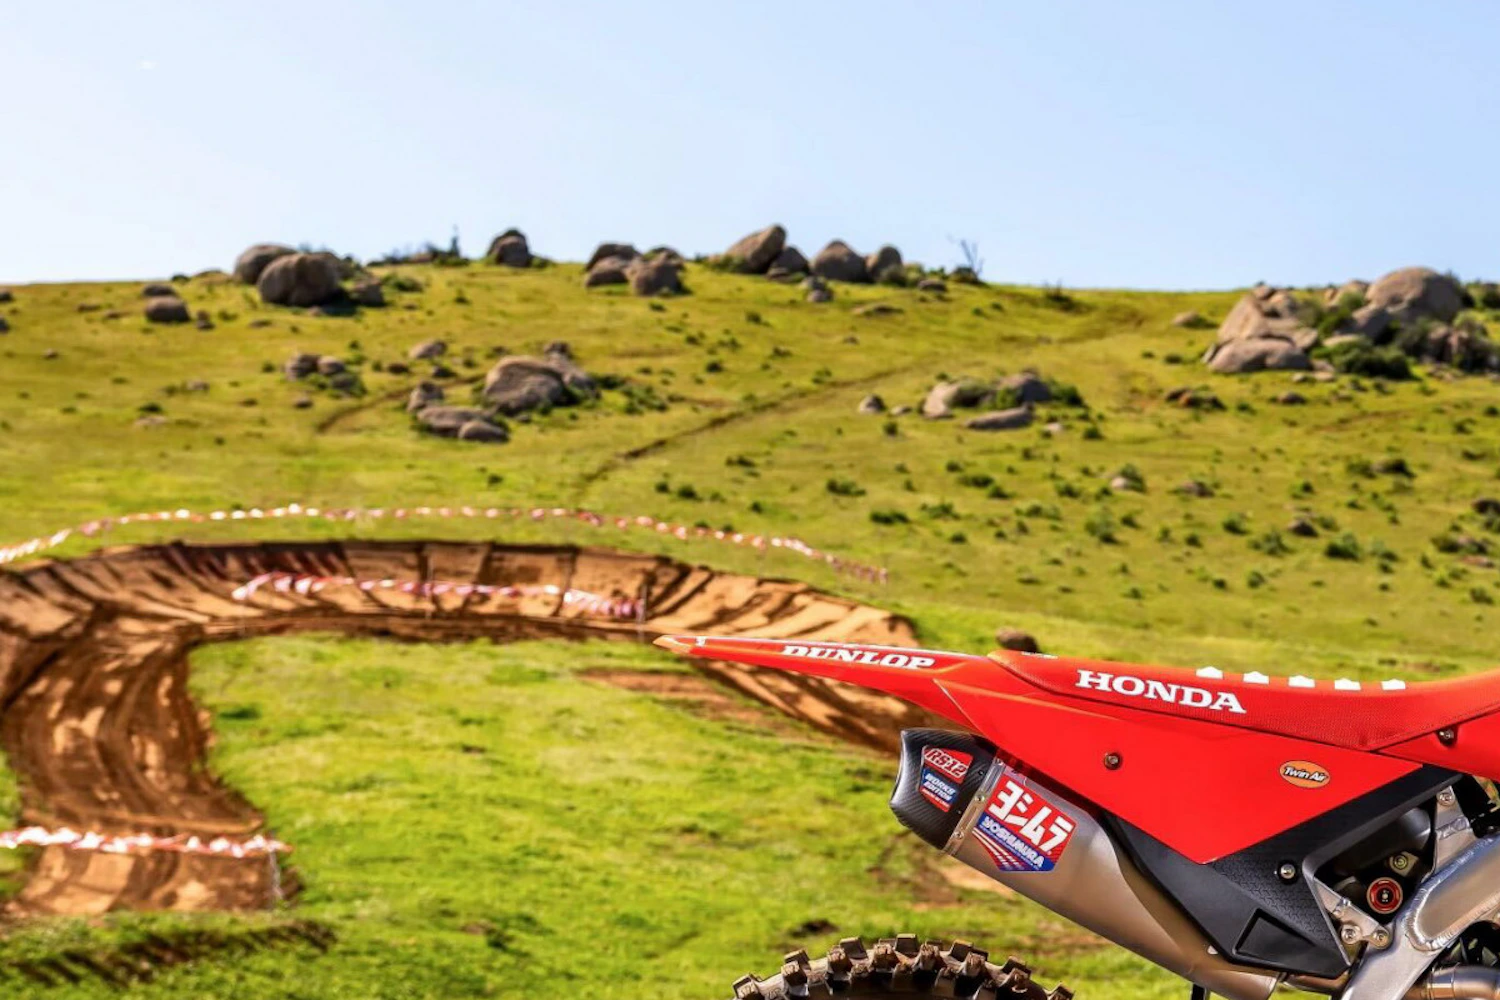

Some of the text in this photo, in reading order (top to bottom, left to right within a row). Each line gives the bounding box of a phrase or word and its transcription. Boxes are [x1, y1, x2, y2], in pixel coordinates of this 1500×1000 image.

[782, 645, 935, 670] DUNLOP
[1075, 669, 1246, 714] HONDA
[925, 773, 956, 796] WORKS
[1284, 766, 1327, 782] Twin Air
[988, 780, 1073, 851] ヨシムラ
[983, 816, 1045, 868] YOSHIMURA
